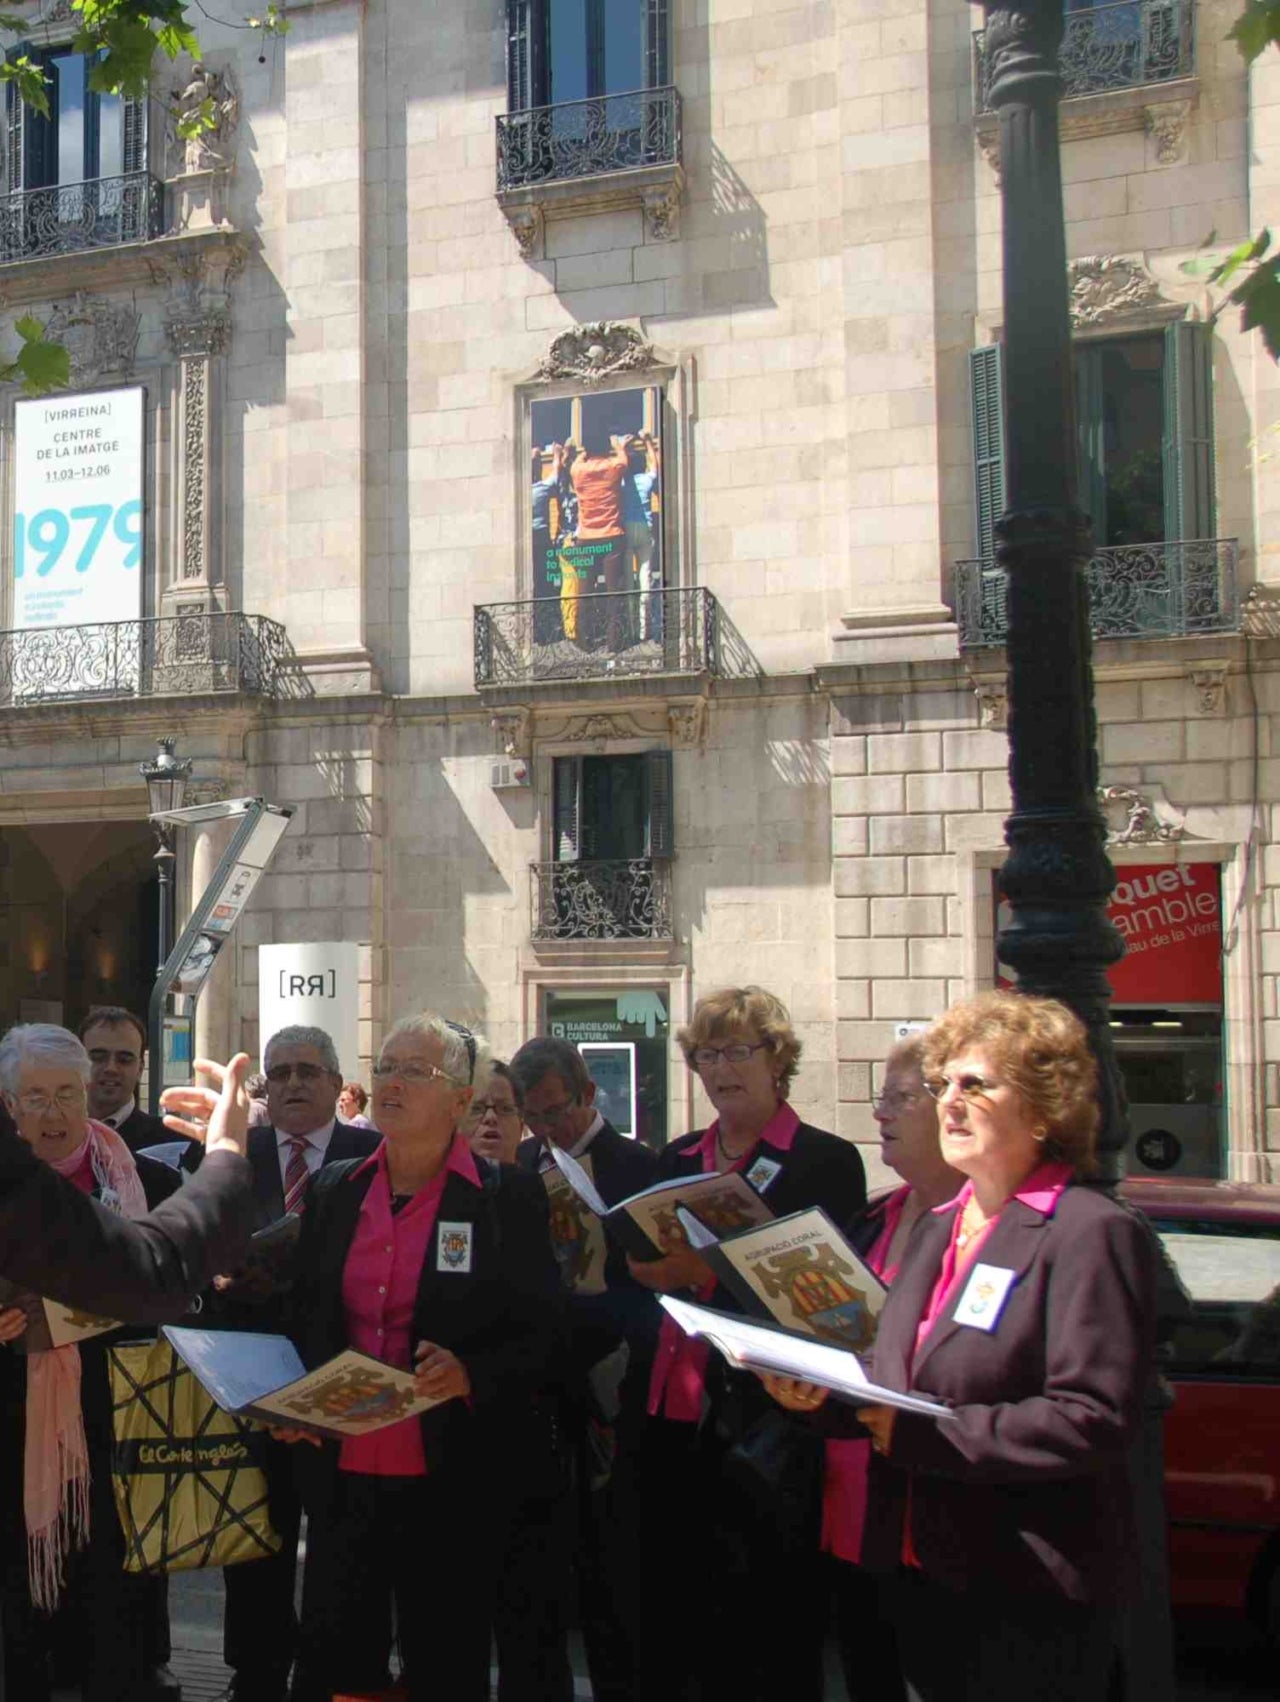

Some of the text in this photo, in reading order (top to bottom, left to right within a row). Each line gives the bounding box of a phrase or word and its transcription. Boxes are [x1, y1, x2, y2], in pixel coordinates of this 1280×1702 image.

[53, 427, 102, 443] CENTRE
[37, 441, 119, 460] DE LA IMATGE
[14, 498, 143, 579] 1979
[547, 549, 554, 558] a
[547, 560, 557, 570] to
[1107, 863, 1196, 907] quet
[1111, 892, 1217, 936] amble
[1150, 934, 1170, 948] de
[567, 1022, 622, 1032] BARCELONA
[567, 1032, 609, 1041] CULTURA
[791, 1229, 823, 1245] CORAL
